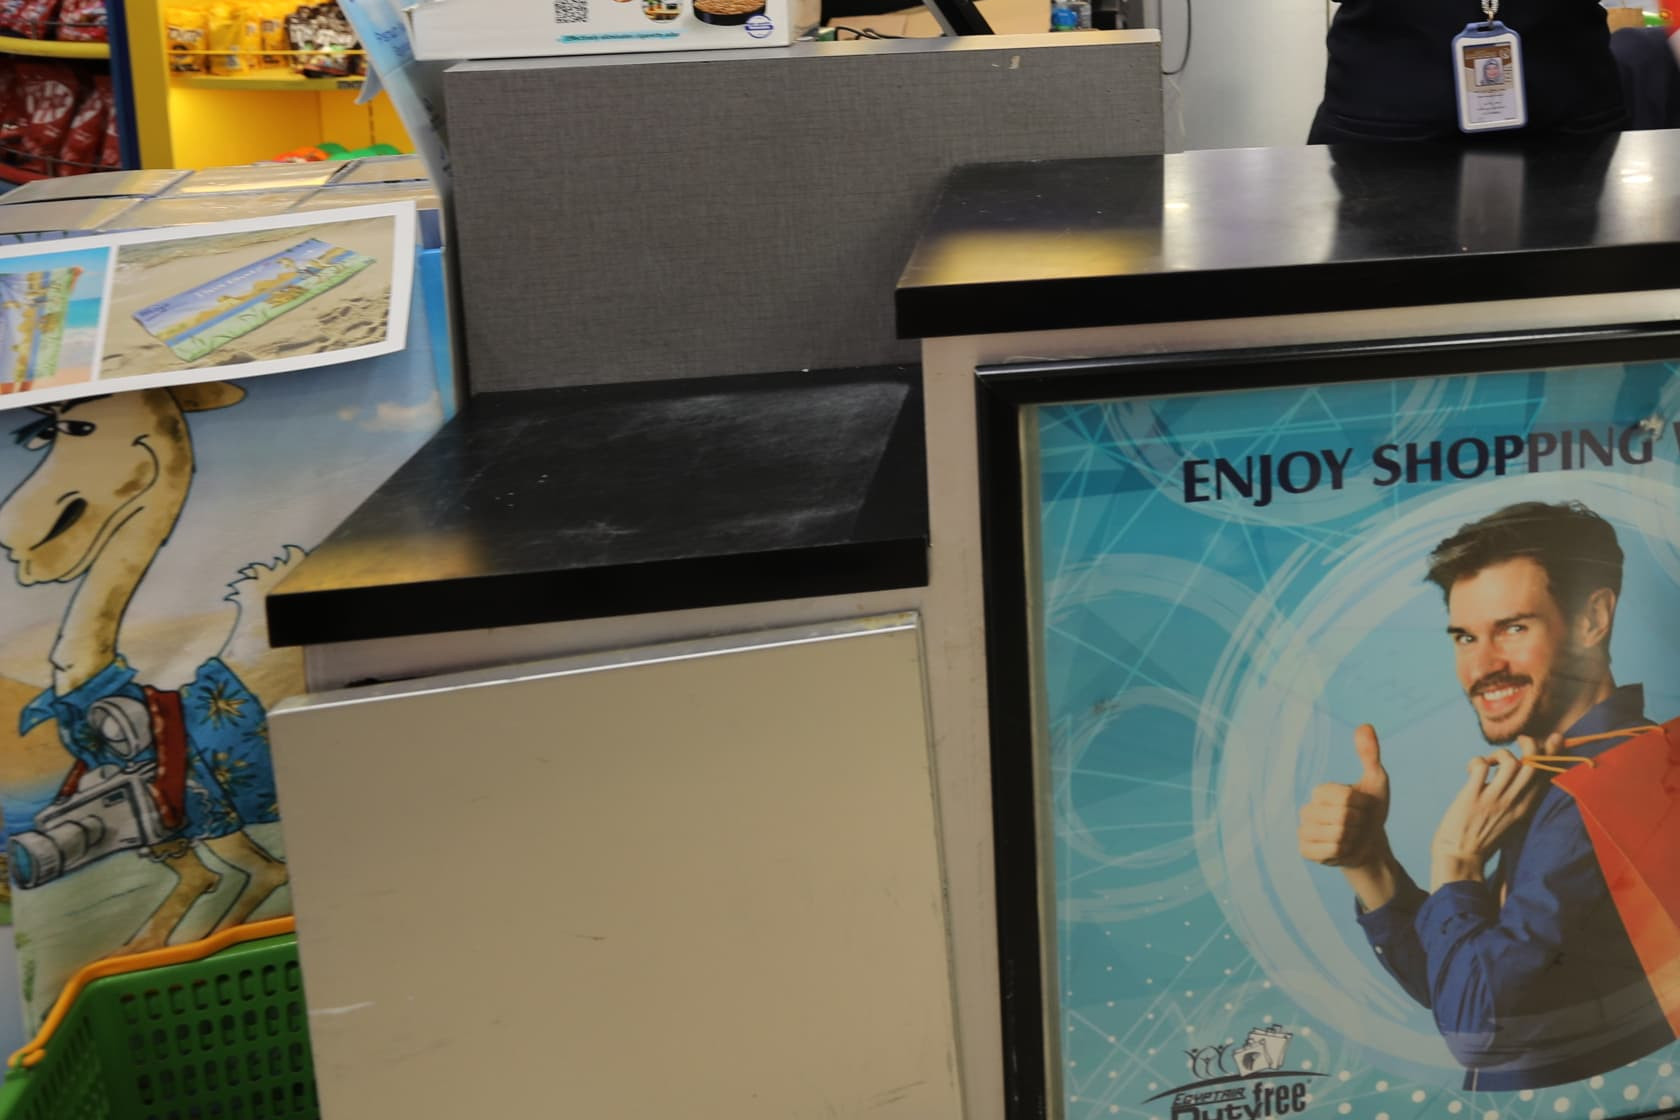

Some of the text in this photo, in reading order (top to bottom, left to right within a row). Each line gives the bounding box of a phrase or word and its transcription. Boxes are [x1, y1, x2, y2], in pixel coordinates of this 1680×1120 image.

[1182, 447, 1354, 508] ENJOY
[1371, 426, 1654, 488] SHOPPING
[1252, 1082, 1307, 1117] free
